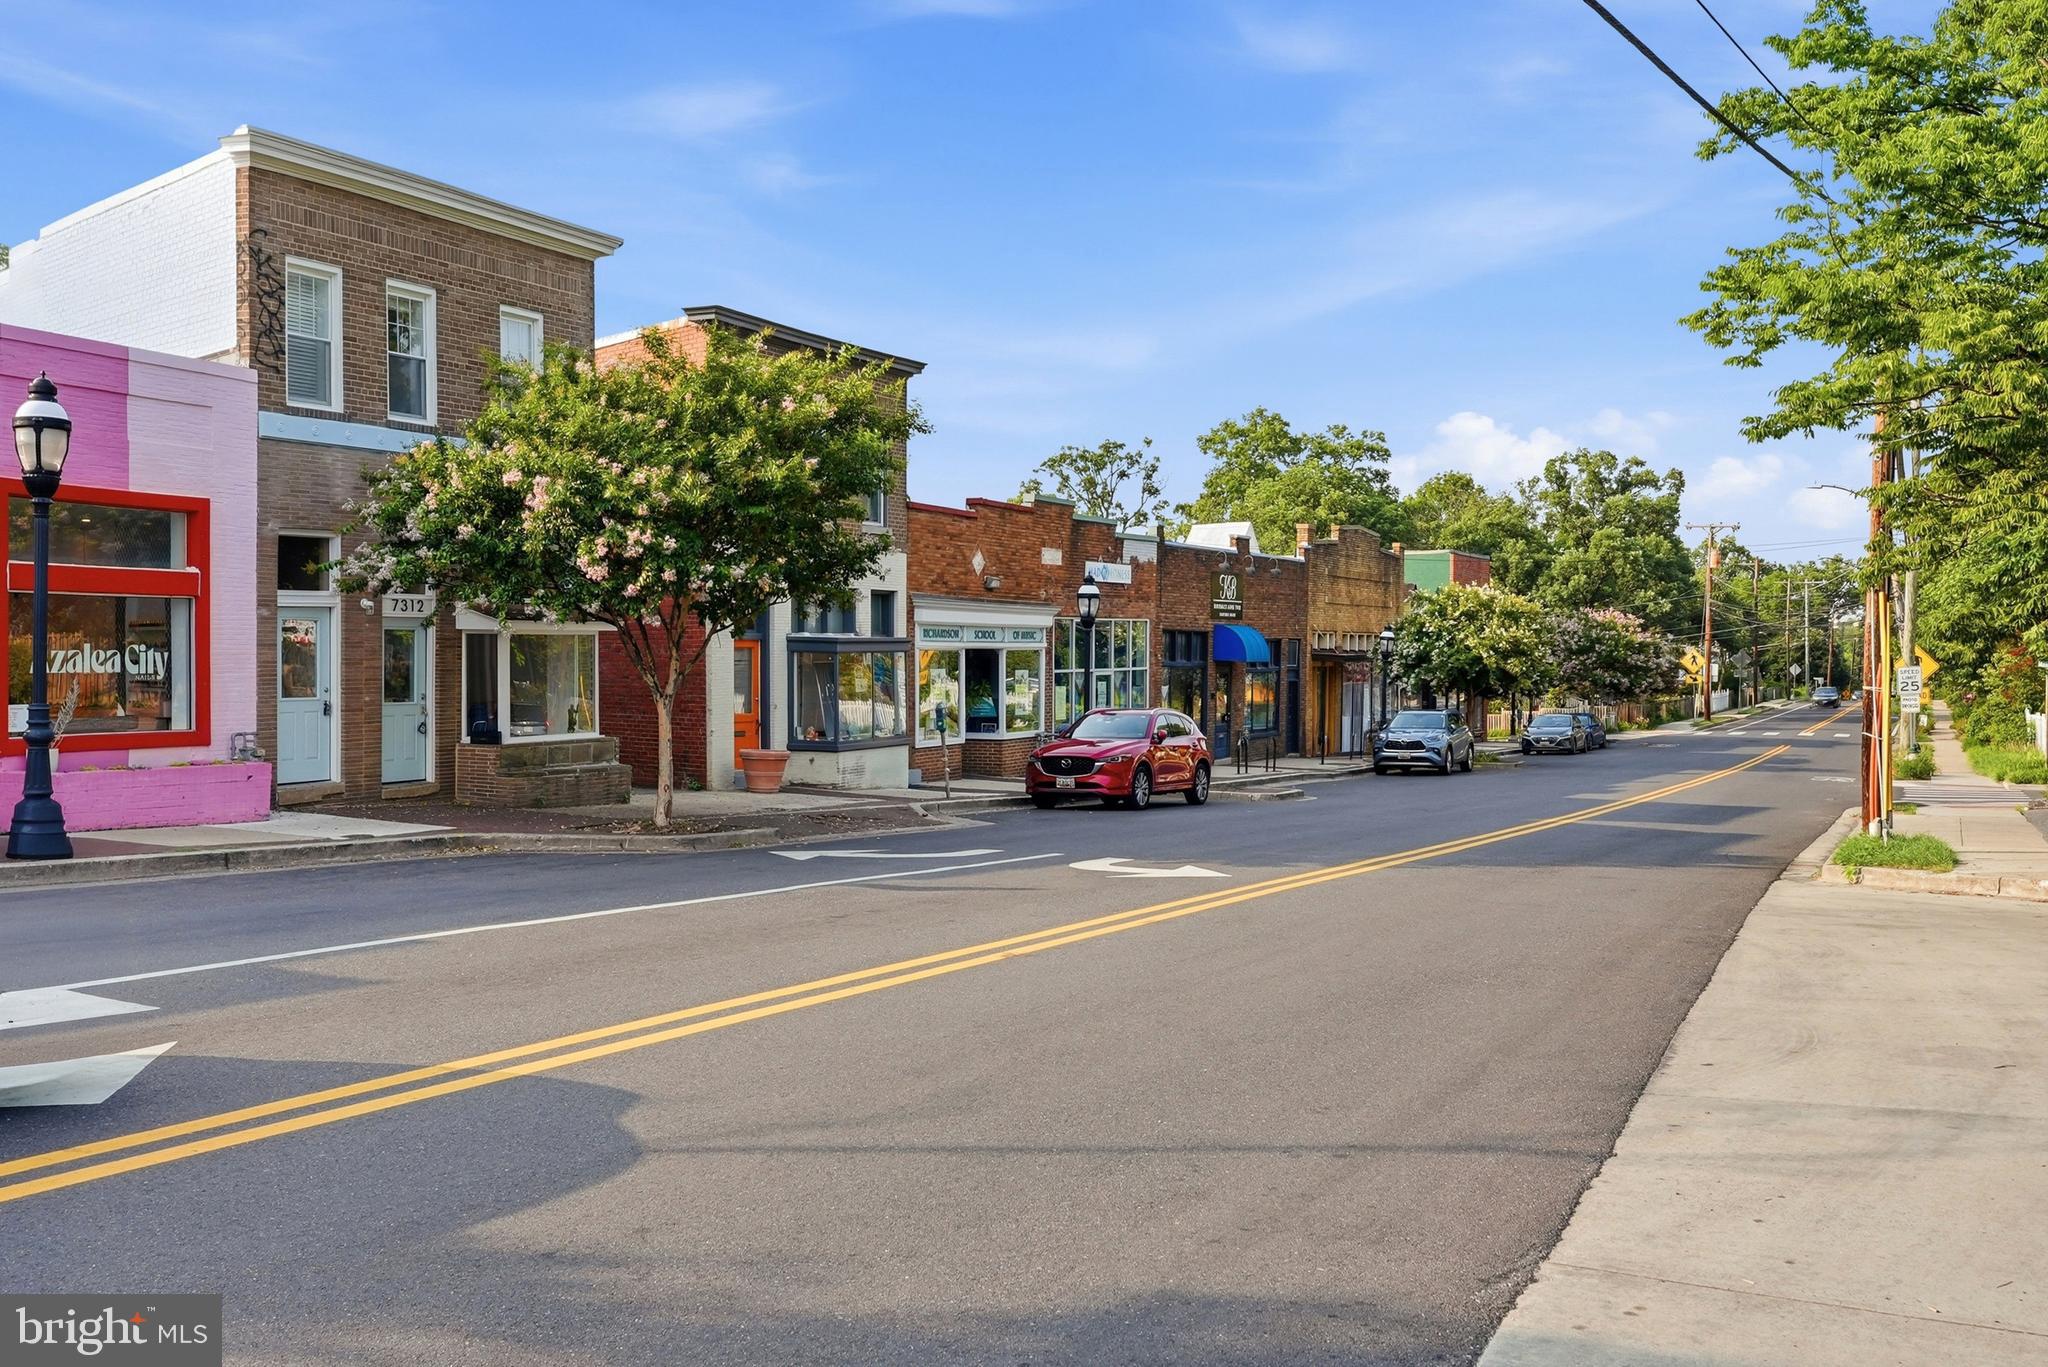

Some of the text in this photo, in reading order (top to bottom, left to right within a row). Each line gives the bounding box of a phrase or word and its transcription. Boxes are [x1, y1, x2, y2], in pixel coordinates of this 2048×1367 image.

[391, 599, 424, 612] 7312
[923, 628, 1037, 640] RICHARDSON SCHOOL OF MUSIC
[124, 644, 168, 680] City
[1900, 681, 1920, 692] 25
